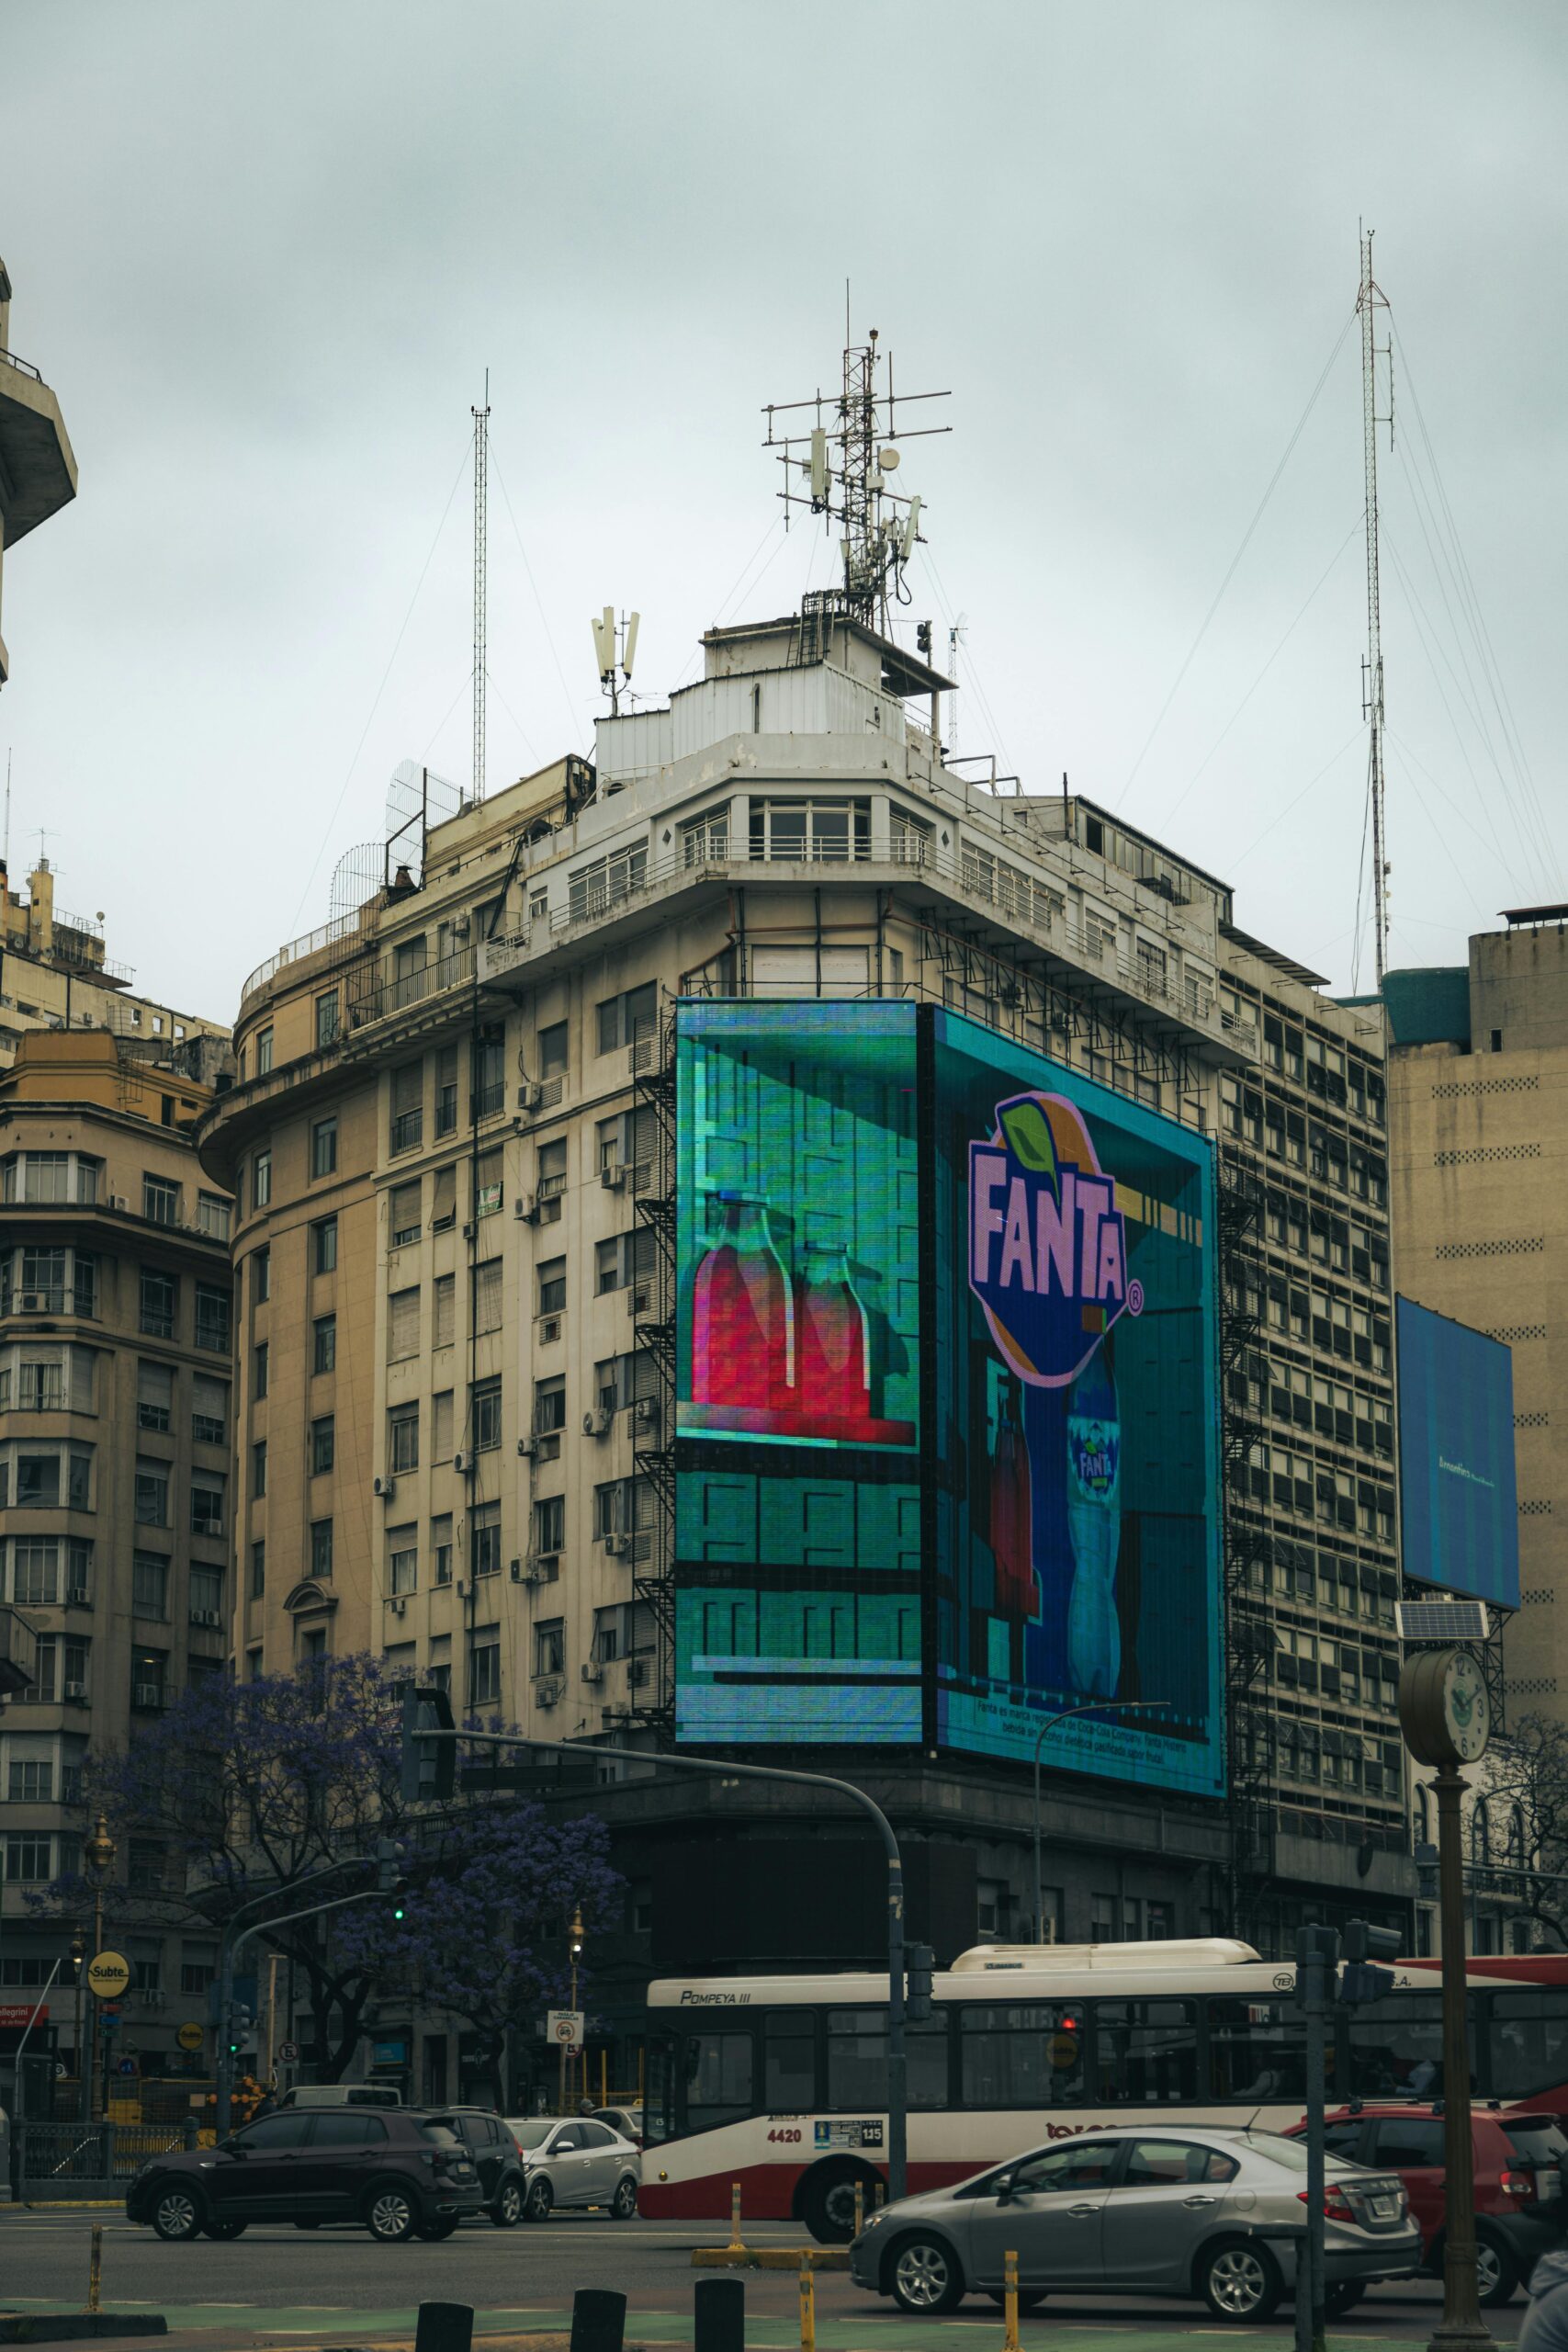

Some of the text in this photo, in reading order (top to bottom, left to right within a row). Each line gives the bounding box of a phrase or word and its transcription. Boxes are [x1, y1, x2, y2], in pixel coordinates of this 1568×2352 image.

[975, 1153, 1123, 1300] FANTA
[1079, 1453, 1111, 1478] FANTA
[977, 1700, 998, 1715] Fanta
[1477, 1698, 1484, 1718] 3
[1461, 1737, 1468, 1757] 6
[93, 1966, 125, 1978] Subte
[739, 1993, 751, 2004] III
[767, 2129, 802, 2143] 4420
[862, 2127, 882, 2141] 115
